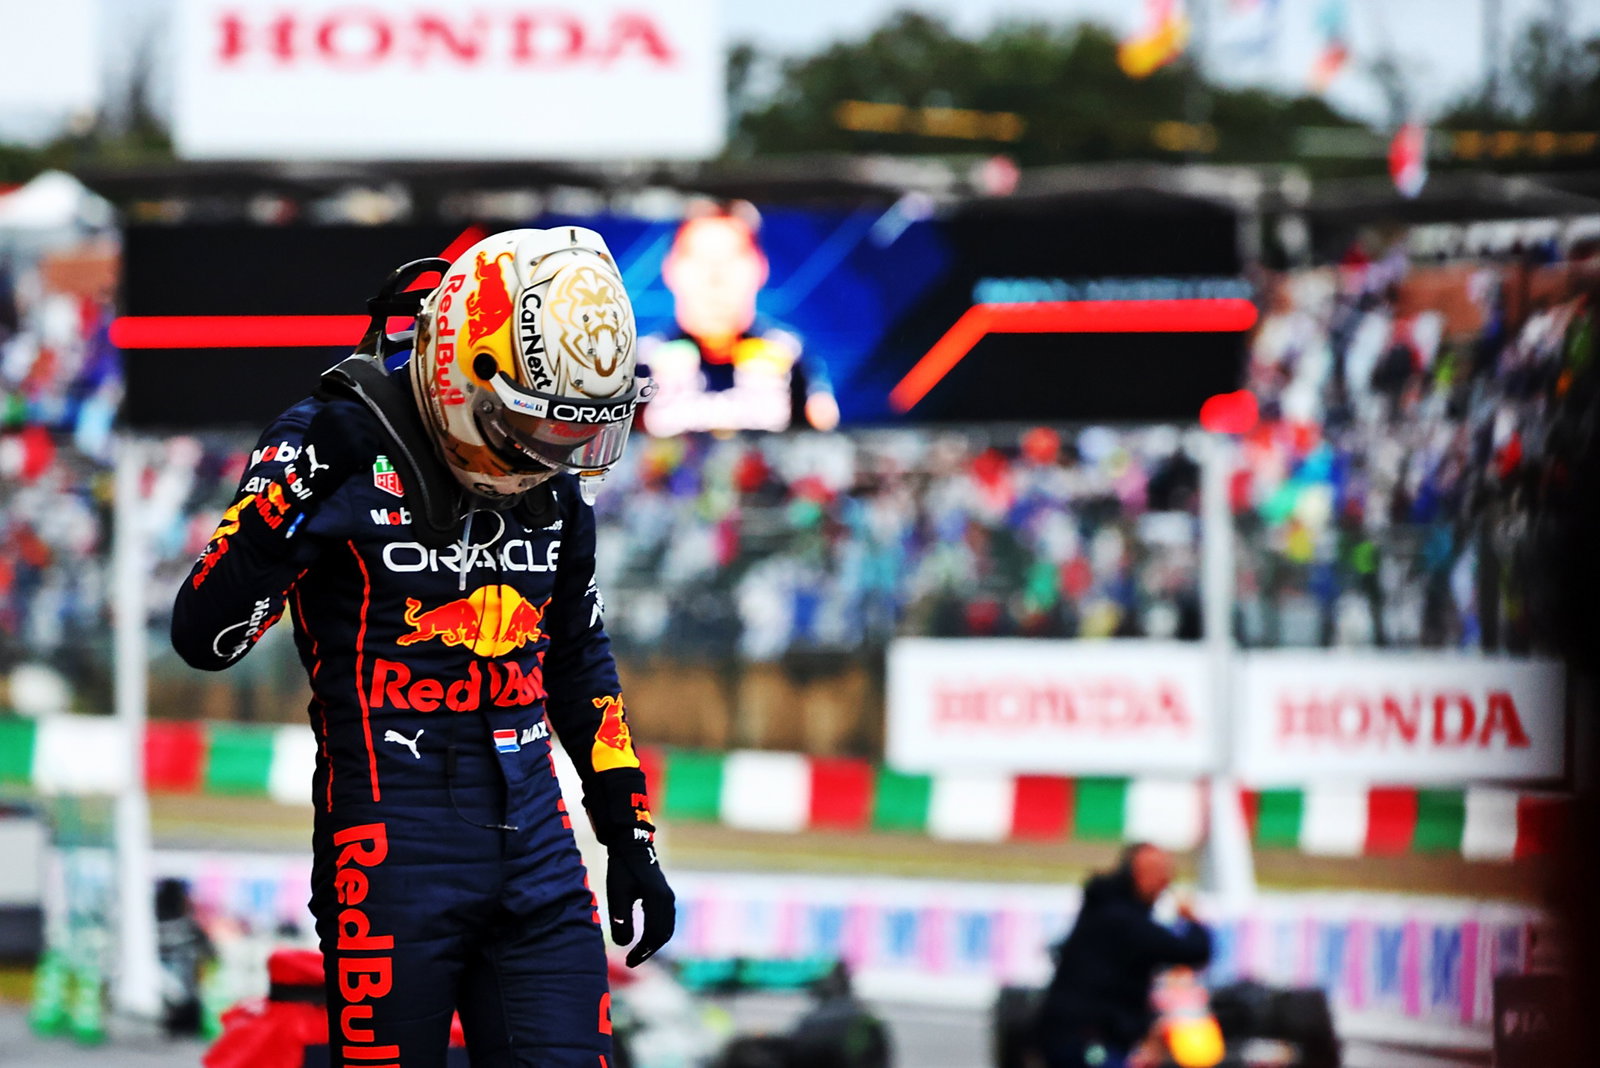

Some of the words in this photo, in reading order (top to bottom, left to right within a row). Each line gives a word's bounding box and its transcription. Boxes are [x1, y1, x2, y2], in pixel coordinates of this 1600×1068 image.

[214, 10, 678, 67] HONDA
[519, 292, 553, 390] CarNext
[369, 506, 413, 526] Mob
[368, 658, 482, 713] Red
[932, 677, 1193, 732] HONDA
[520, 720, 550, 746] MAX
[1276, 691, 1531, 750] HONDA
